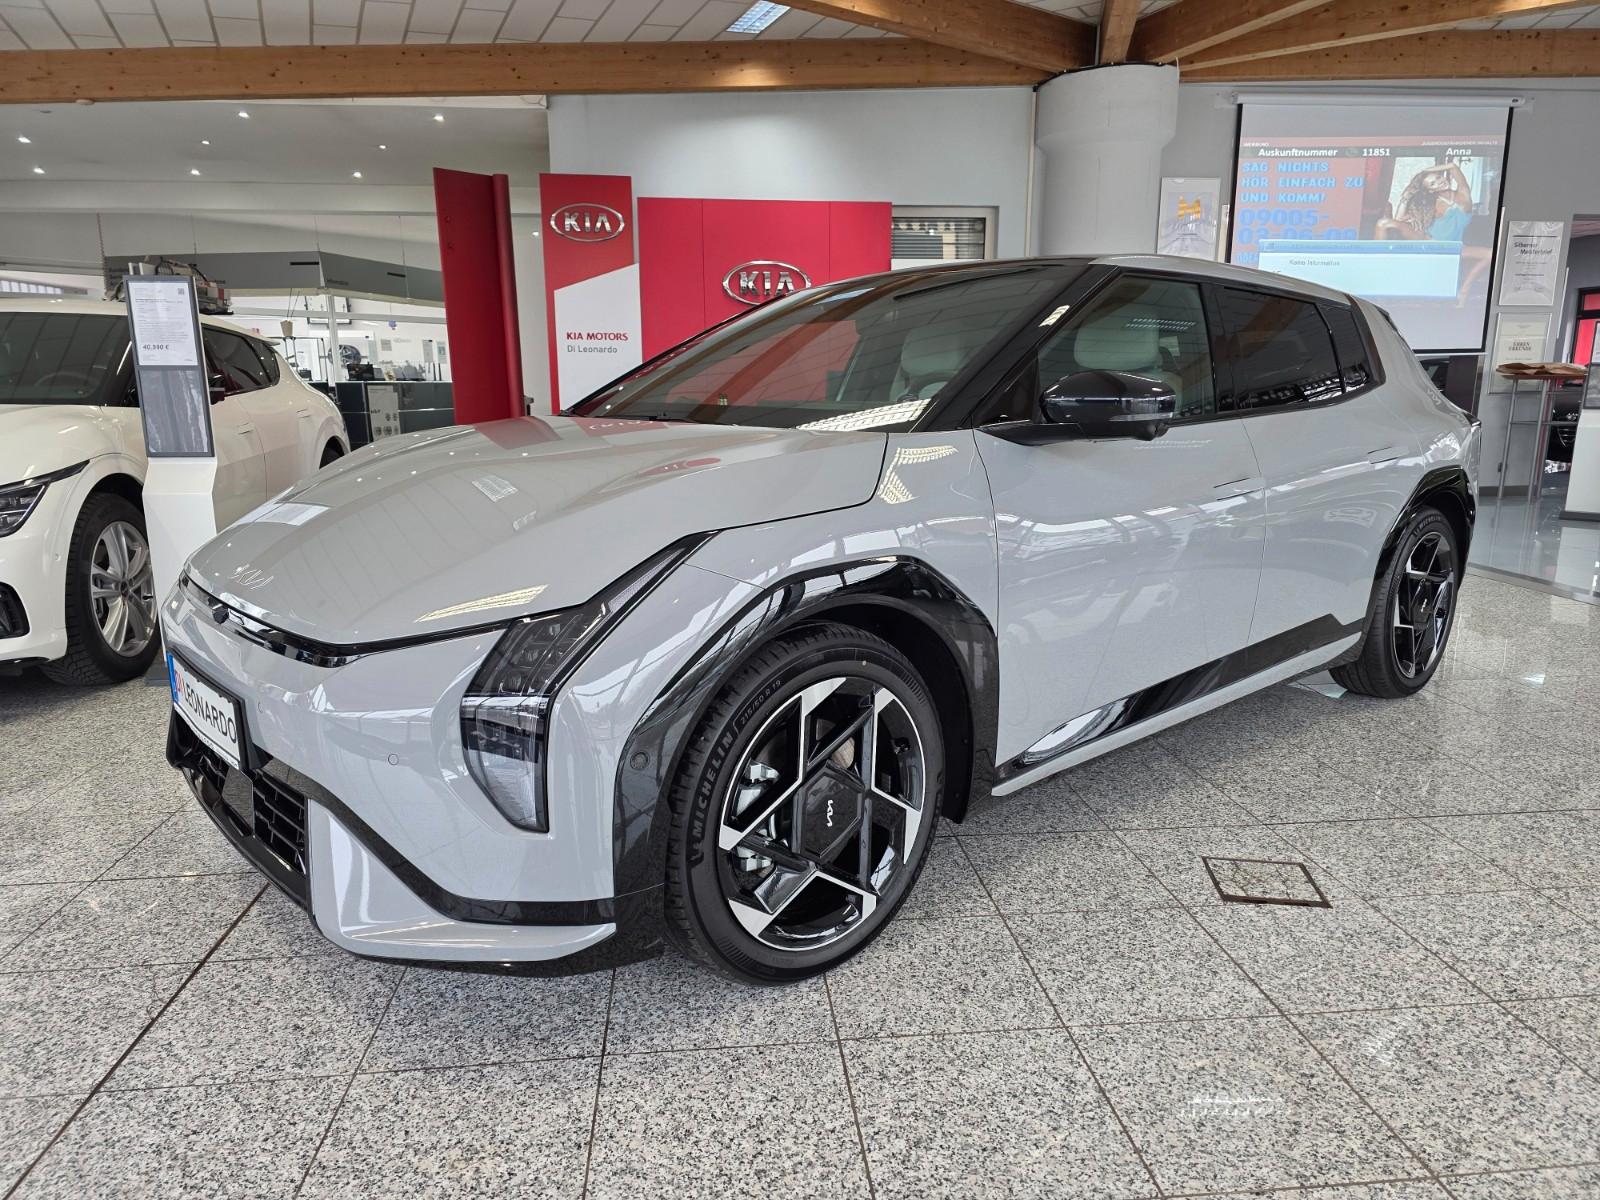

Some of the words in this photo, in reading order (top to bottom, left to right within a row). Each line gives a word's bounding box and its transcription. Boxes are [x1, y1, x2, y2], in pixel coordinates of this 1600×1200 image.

[1258, 148, 1338, 157] Auskunftnummer
[1362, 148, 1391, 157] 11851
[1446, 147, 1472, 156] Anna
[1243, 162, 1269, 172] SAG
[1277, 162, 1329, 172] NICHTS
[1241, 174, 1269, 188] HÖR
[1278, 177, 1337, 188] EINFACH
[1344, 176, 1364, 188] ZU
[1240, 192, 1269, 203] UND
[564, 212, 612, 232] KIA
[739, 271, 795, 297] KIA
[566, 332, 585, 341] KIA
[586, 332, 629, 341] MOTORS
[567, 345, 576, 353] Di
[578, 345, 618, 354] Leonardo
[183, 683, 237, 744] LEONARDO
[692, 731, 735, 838] MICHELIN
